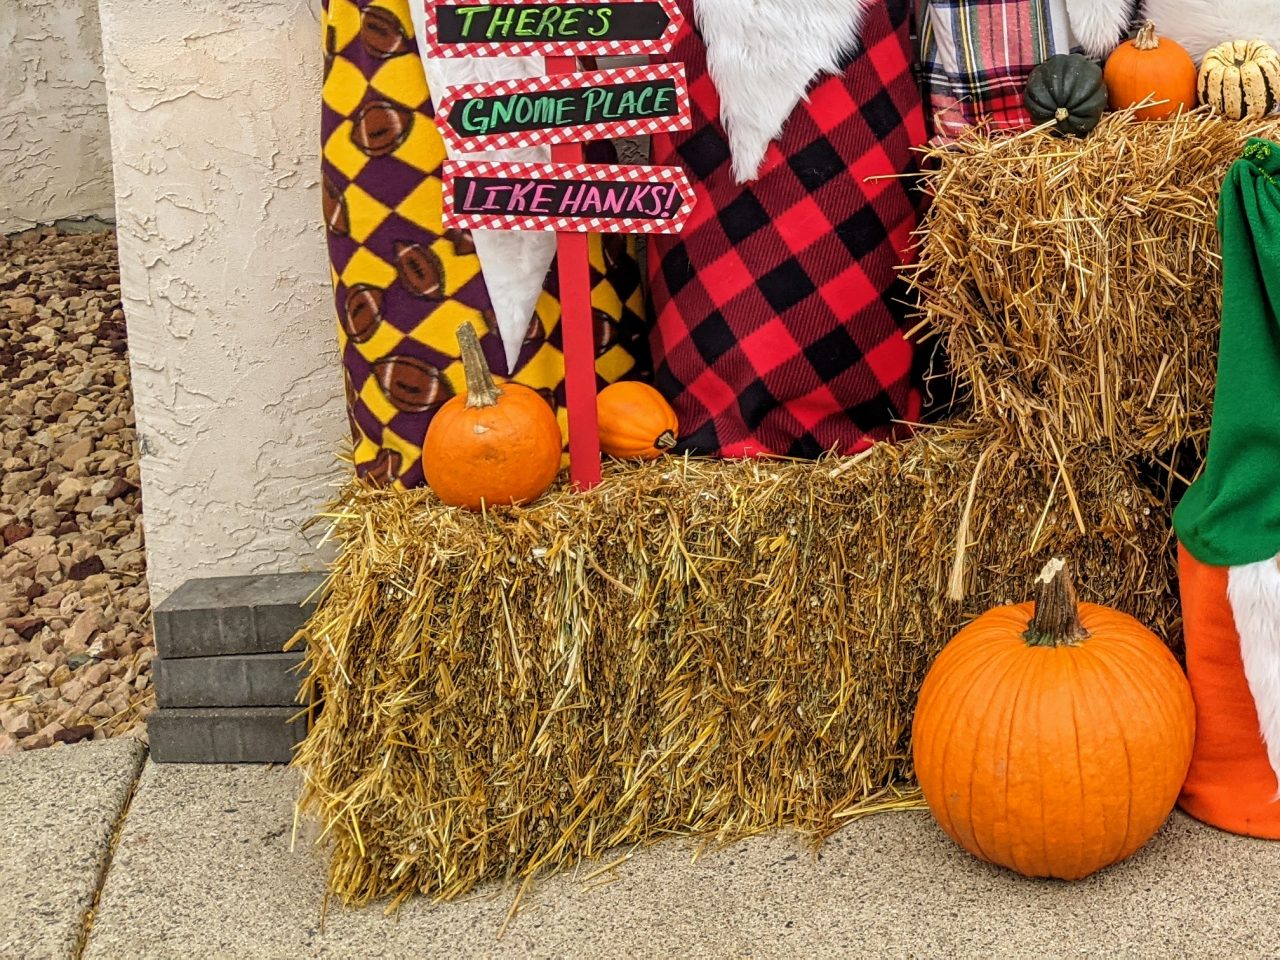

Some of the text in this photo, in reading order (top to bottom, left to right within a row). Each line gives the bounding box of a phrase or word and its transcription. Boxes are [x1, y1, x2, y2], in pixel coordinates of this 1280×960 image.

[455, 5, 612, 38] THERE'S
[461, 86, 674, 134] GNOME PLACE
[462, 179, 678, 218] LIKE HANKS!
